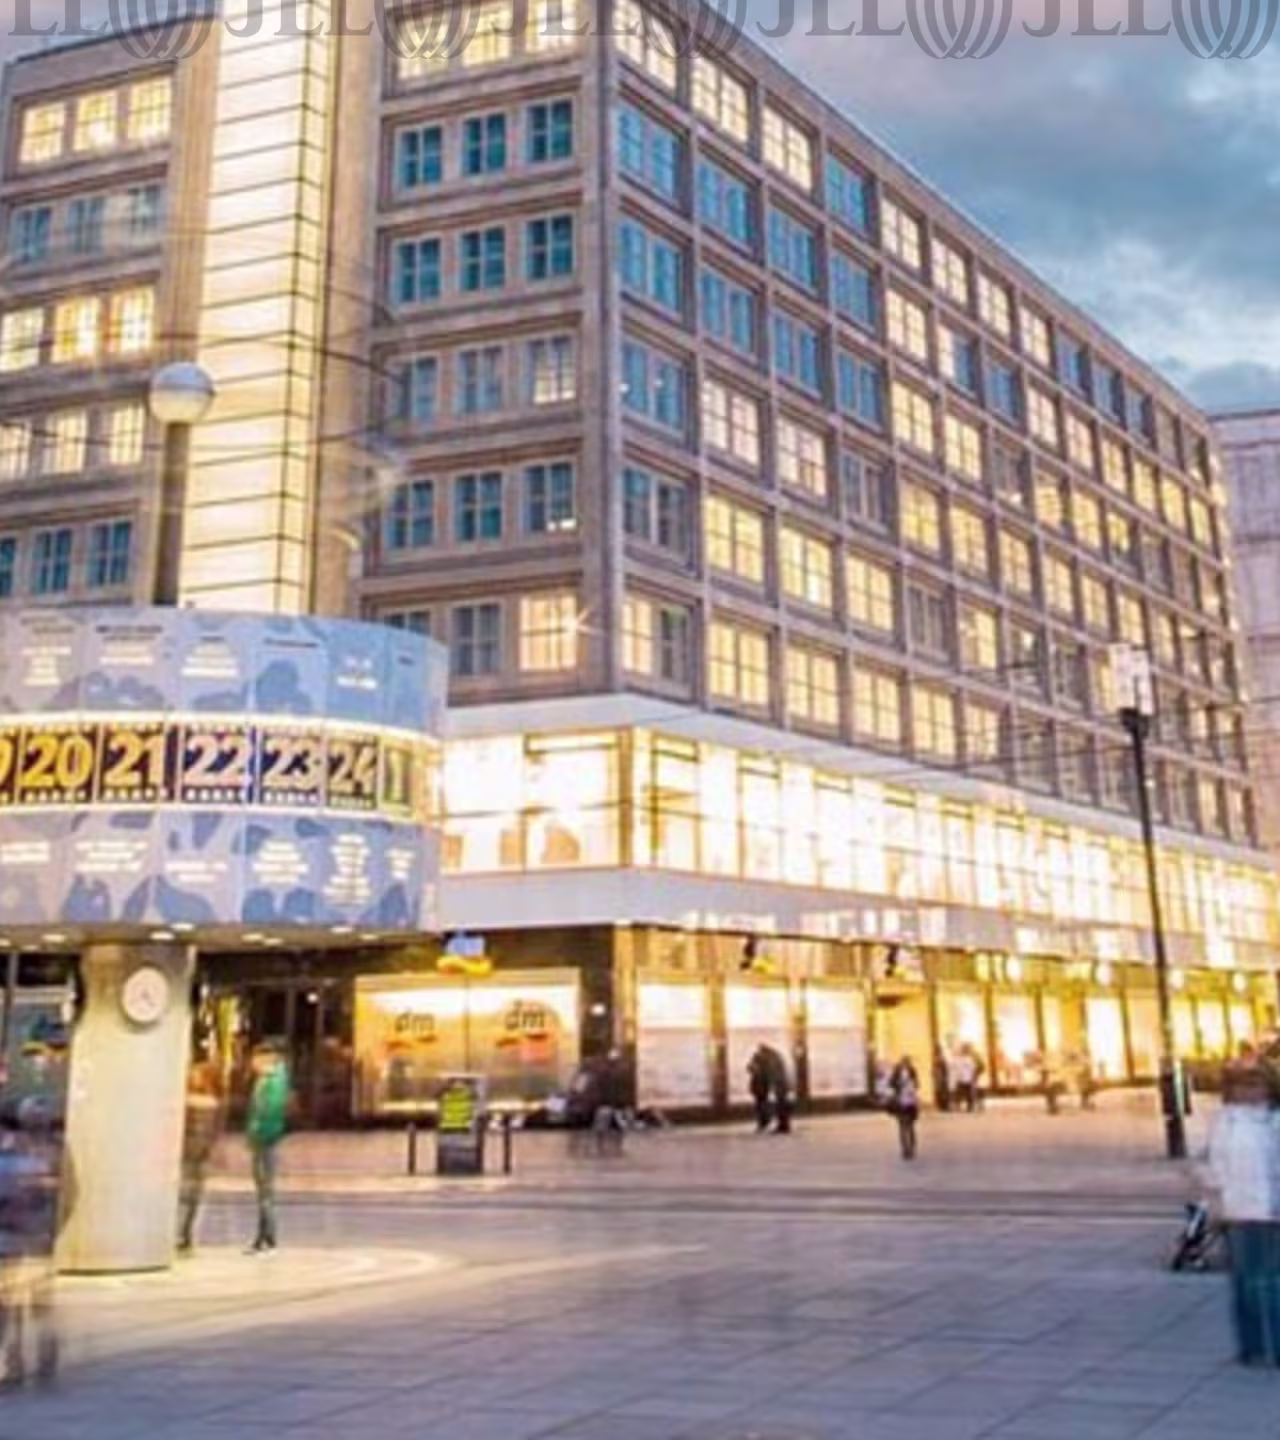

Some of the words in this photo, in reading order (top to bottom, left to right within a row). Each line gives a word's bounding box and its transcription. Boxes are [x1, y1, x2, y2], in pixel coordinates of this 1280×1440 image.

[20, 734, 94, 789] 20
[104, 731, 163, 786] 21
[183, 733, 255, 787] 22
[262, 735, 321, 790] 23
[328, 741, 377, 795] 24
[504, 1000, 546, 1031] dm
